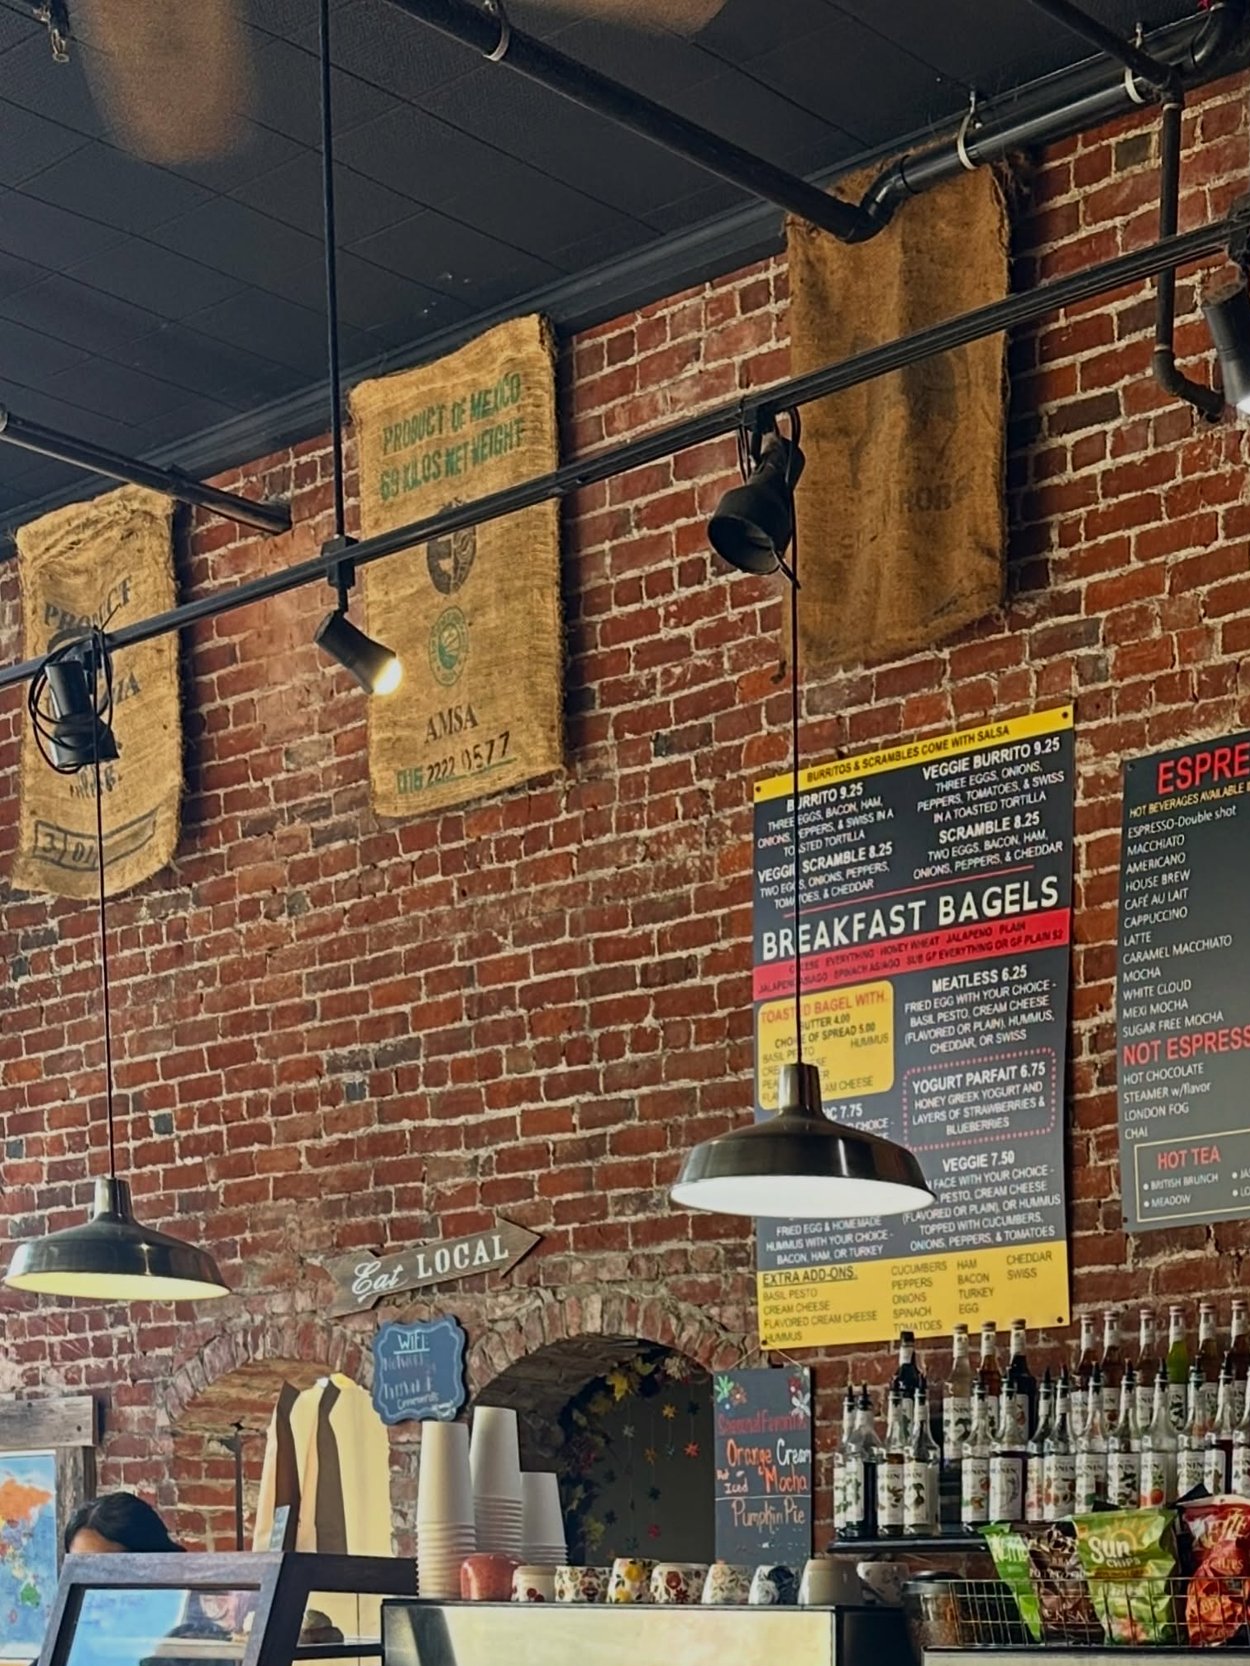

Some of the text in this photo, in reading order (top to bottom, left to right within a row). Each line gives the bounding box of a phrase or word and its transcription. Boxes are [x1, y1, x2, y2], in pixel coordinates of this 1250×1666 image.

[383, 372, 521, 456] PRODUCT OF MEXICO
[402, 449, 442, 493] KILOS
[445, 441, 470, 478] NET
[471, 417, 524, 467] WEIGHT
[424, 703, 478, 744] AMSA
[806, 761, 852, 784] BURRITOS
[861, 745, 920, 770] SCRAMBLES
[920, 738, 949, 757] COME
[950, 732, 976, 749] WITH
[976, 723, 1010, 743] SALSA
[921, 736, 1060, 782] VEGGIE BURRITO 9.25
[938, 810, 1040, 846] SCRAMBLE 8.25
[1126, 832, 1185, 858] MACCHIATO
[1124, 851, 1186, 876] AMERICANO
[1124, 868, 1191, 894] HOUSE BREW
[762, 873, 1058, 961] BREAKFAST BAGELS
[1123, 905, 1188, 930] CAPPUCCINO
[1121, 933, 1232, 966] CARAMEL MACCHIATO
[1122, 930, 1151, 948] LATTE
[931, 963, 1027, 994] MEATLESS 6.25
[1121, 965, 1162, 985] MOCHA
[1121, 978, 1192, 1002] WHITE CLOUD
[1122, 1039, 1162, 1068] NOT
[911, 1060, 1046, 1096] YOGURT PARFAIT 6.75
[1123, 1104, 1167, 1123] LONDON
[1167, 1100, 1190, 1116] FOG
[1123, 1125, 1149, 1141] CHAI
[941, 1149, 1015, 1174] VEGGIE 7.50
[1156, 1144, 1222, 1171] HOT TEA
[352, 1235, 509, 1299] Eat LOCAL
[1005, 1250, 1053, 1266] CHEDDAR
[763, 1270, 800, 1287] EXTRA
[956, 1271, 990, 1286] BACON
[1006, 1266, 1038, 1282] SWISS
[957, 1285, 994, 1301] TURKEY
[957, 1301, 980, 1316] EGG
[727, 1438, 811, 1472] Orange Cream
[724, 1479, 748, 1494] Iced
[764, 1465, 809, 1494] Mocha
[731, 1495, 806, 1533] Pumpkin Pie
[1087, 1535, 1132, 1564] Sun
[1106, 1557, 1141, 1569] CHIPS
